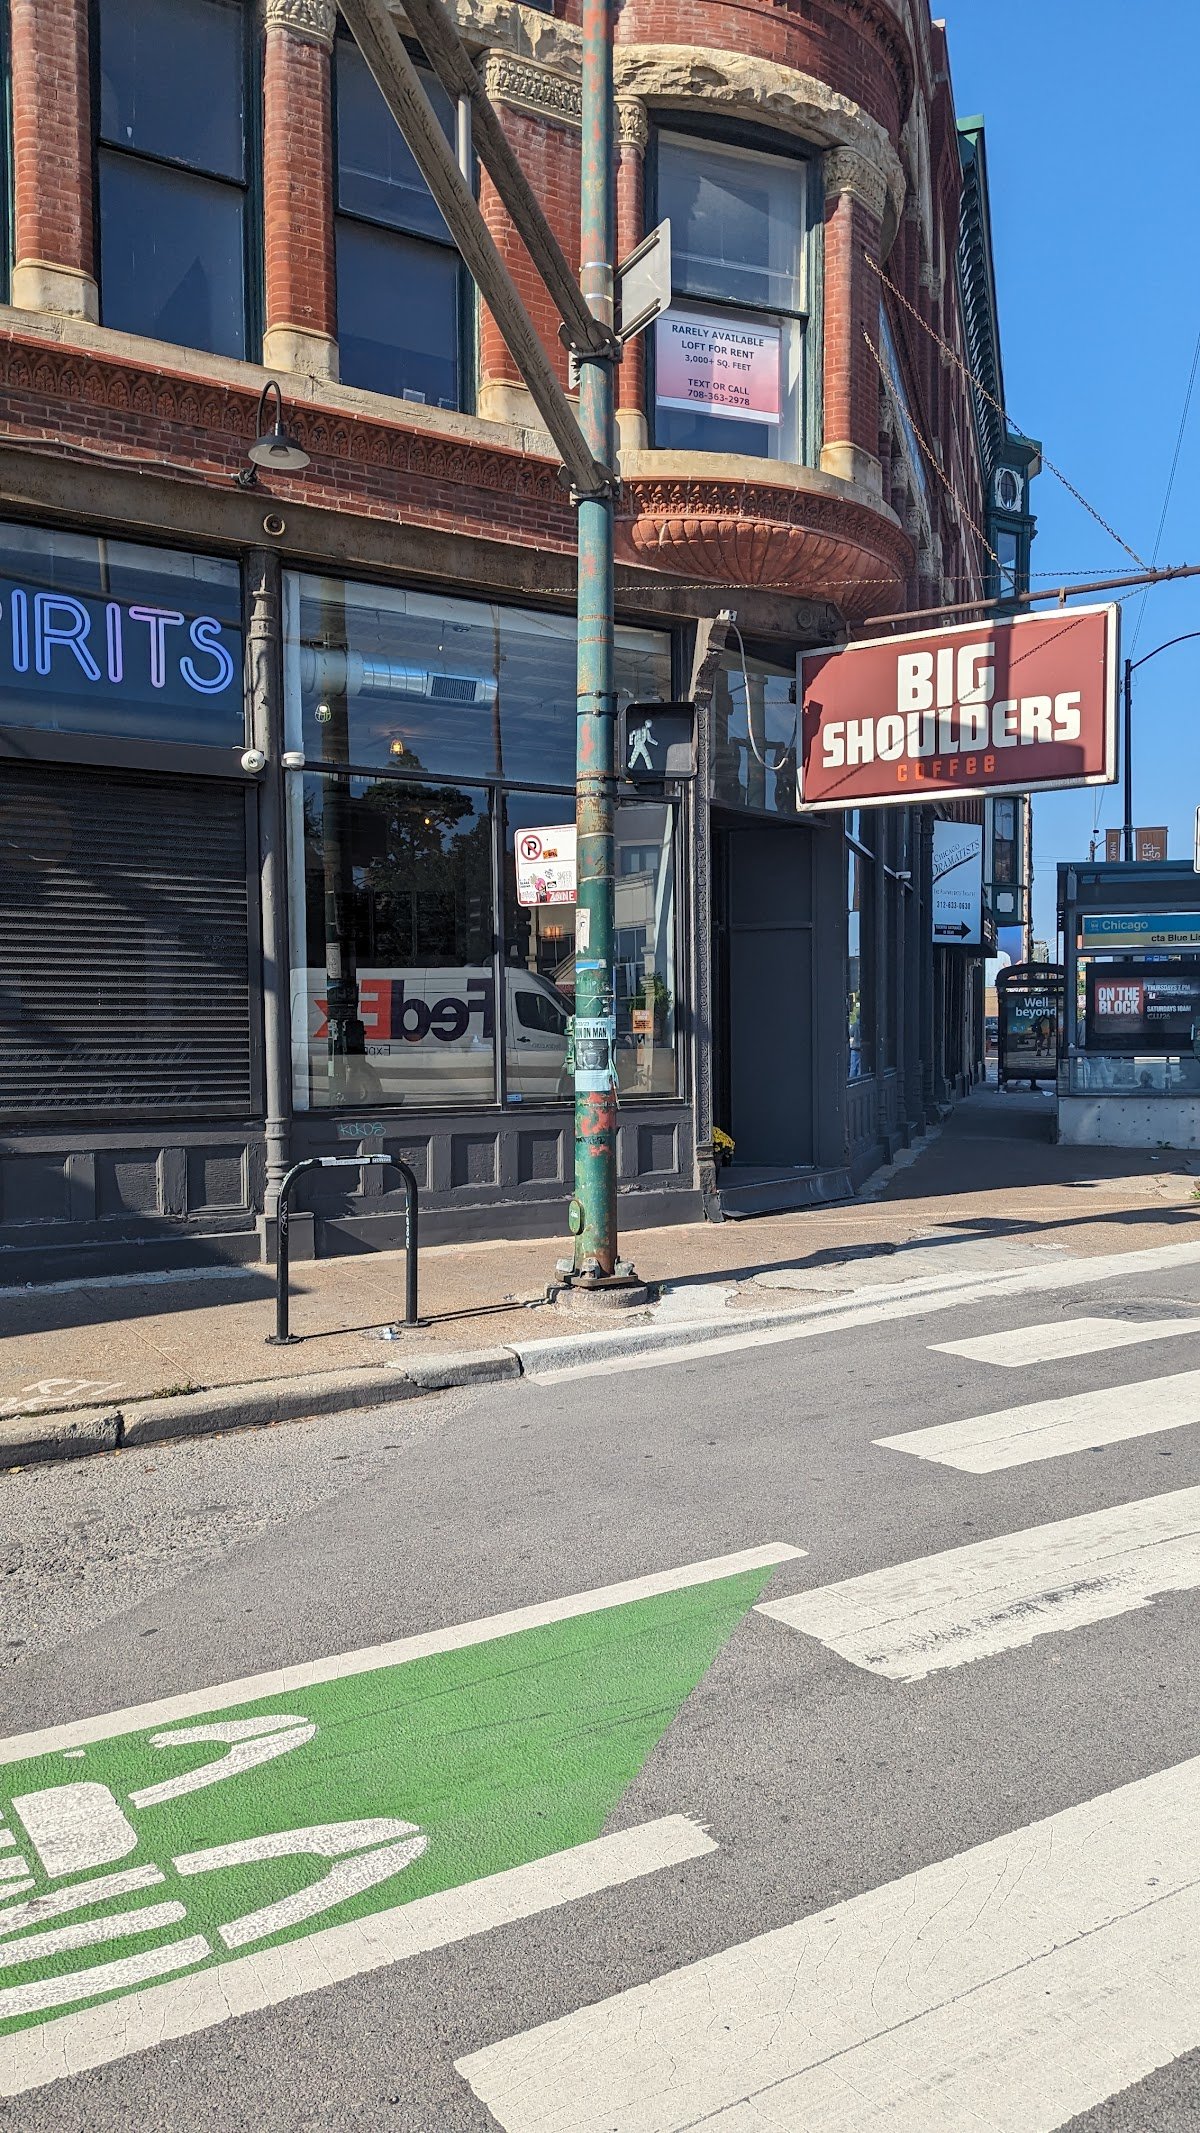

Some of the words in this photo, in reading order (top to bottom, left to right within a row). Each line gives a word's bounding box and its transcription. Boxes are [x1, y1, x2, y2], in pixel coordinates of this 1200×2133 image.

[671, 324, 709, 338] RARELY
[711, 331, 764, 347] AVAILABLE
[681, 340, 706, 352] LOFT
[708, 344, 728, 355] FOR
[730, 348, 755, 360] RENT
[684, 354, 714, 365] 3,000+
[716, 359, 730, 369] SQ.
[732, 362, 751, 371] FEET
[688, 378, 710, 389] TEXT
[712, 382, 726, 391] OR
[728, 386, 750, 395] CALL
[687, 389, 750, 405] 708-363-2978
[0, 588, 234, 694] IRITS
[897, 641, 996, 713] BIG
[822, 690, 1082, 769] SHOULDERS
[1109, 842, 1117, 862] OWN
[549, 890, 575, 902] ZONE
[1102, 920, 1149, 932] Chicago
[1151, 934, 1165, 942] cta
[1167, 933, 1188, 942] Blue
[1098, 987, 1115, 1001] ON
[1117, 986, 1140, 1001] THE
[1023, 997, 1049, 1008] Well
[1098, 1000, 1140, 1015] BLOCK
[1015, 1006, 1057, 1019] beyond
[592, 1027, 607, 1039] MAN
